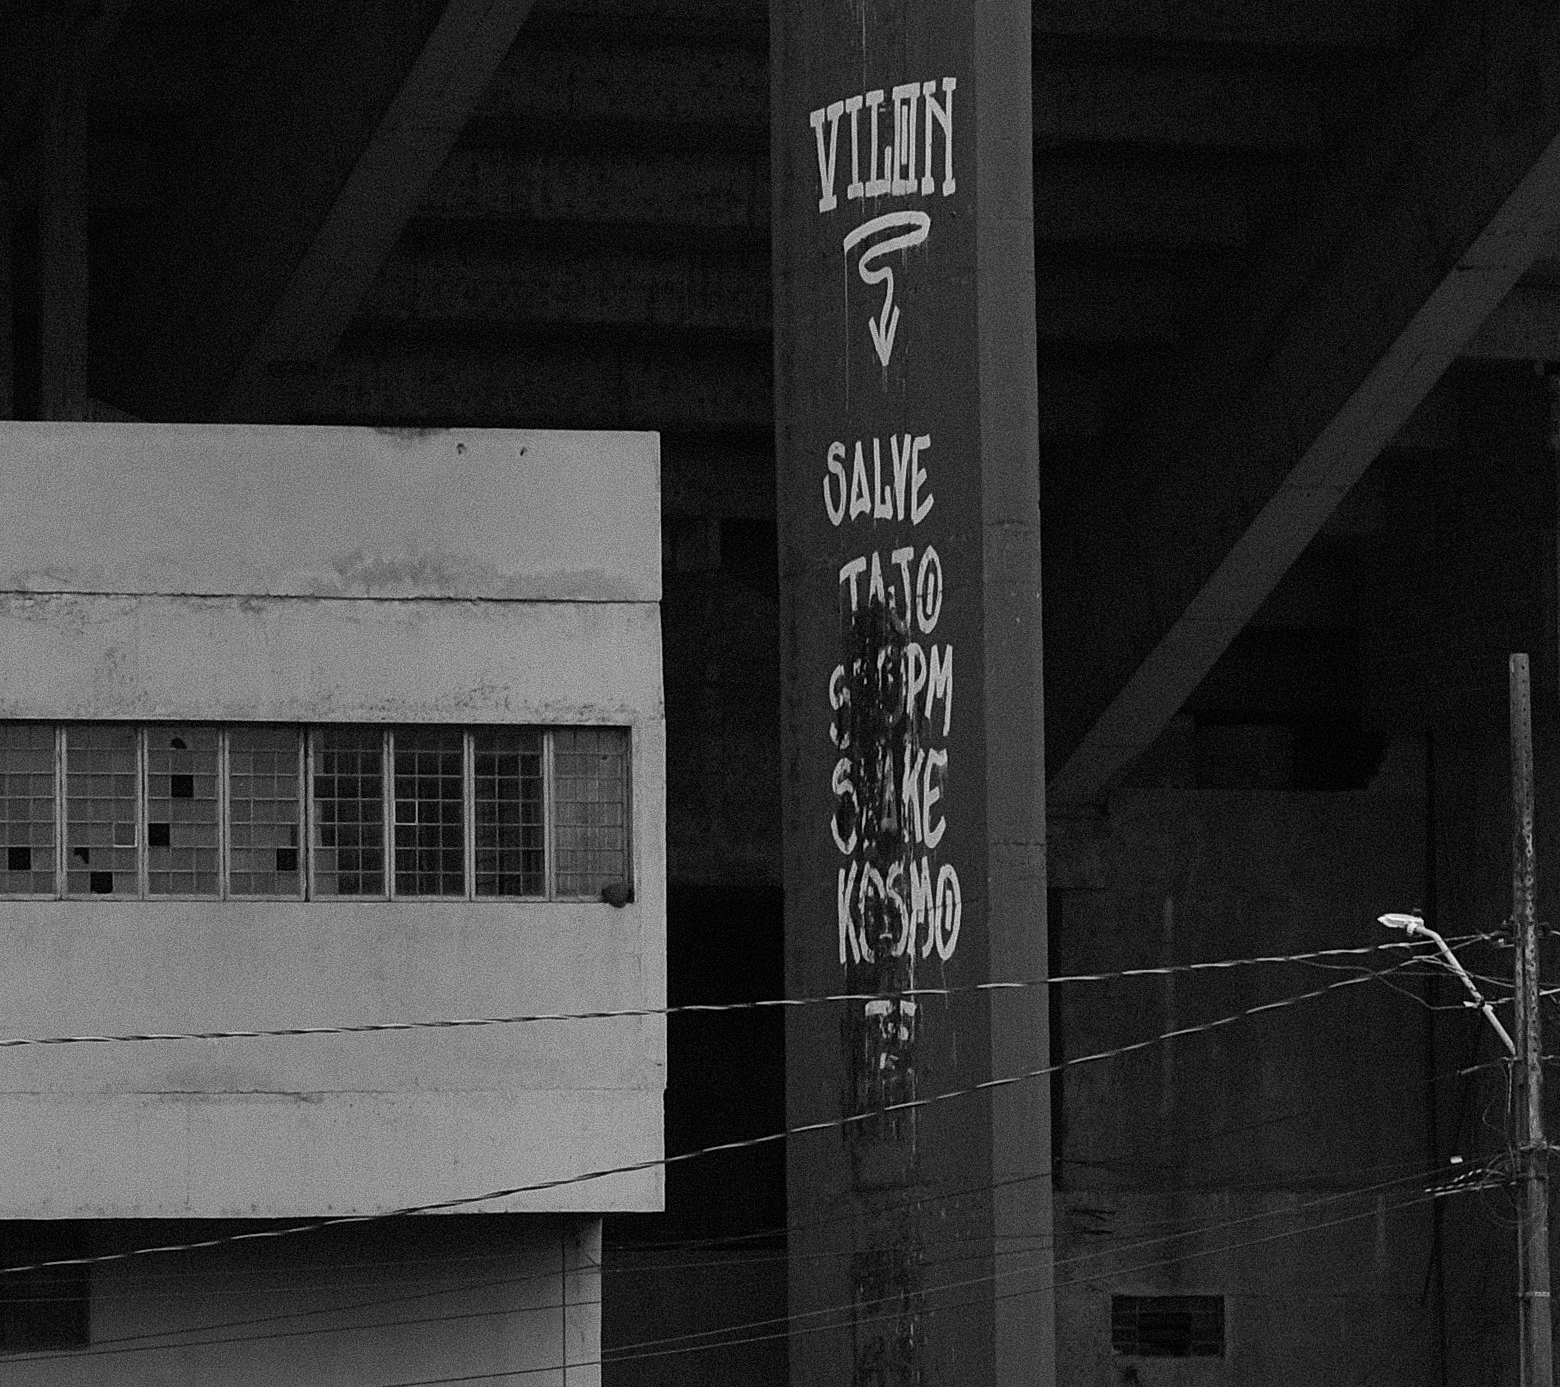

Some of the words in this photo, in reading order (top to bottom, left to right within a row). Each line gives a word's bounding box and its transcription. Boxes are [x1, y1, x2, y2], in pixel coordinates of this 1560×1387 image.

[823, 432, 934, 527] SALVE
[831, 747, 948, 855] SAKE
[838, 856, 962, 964] KOSMO
